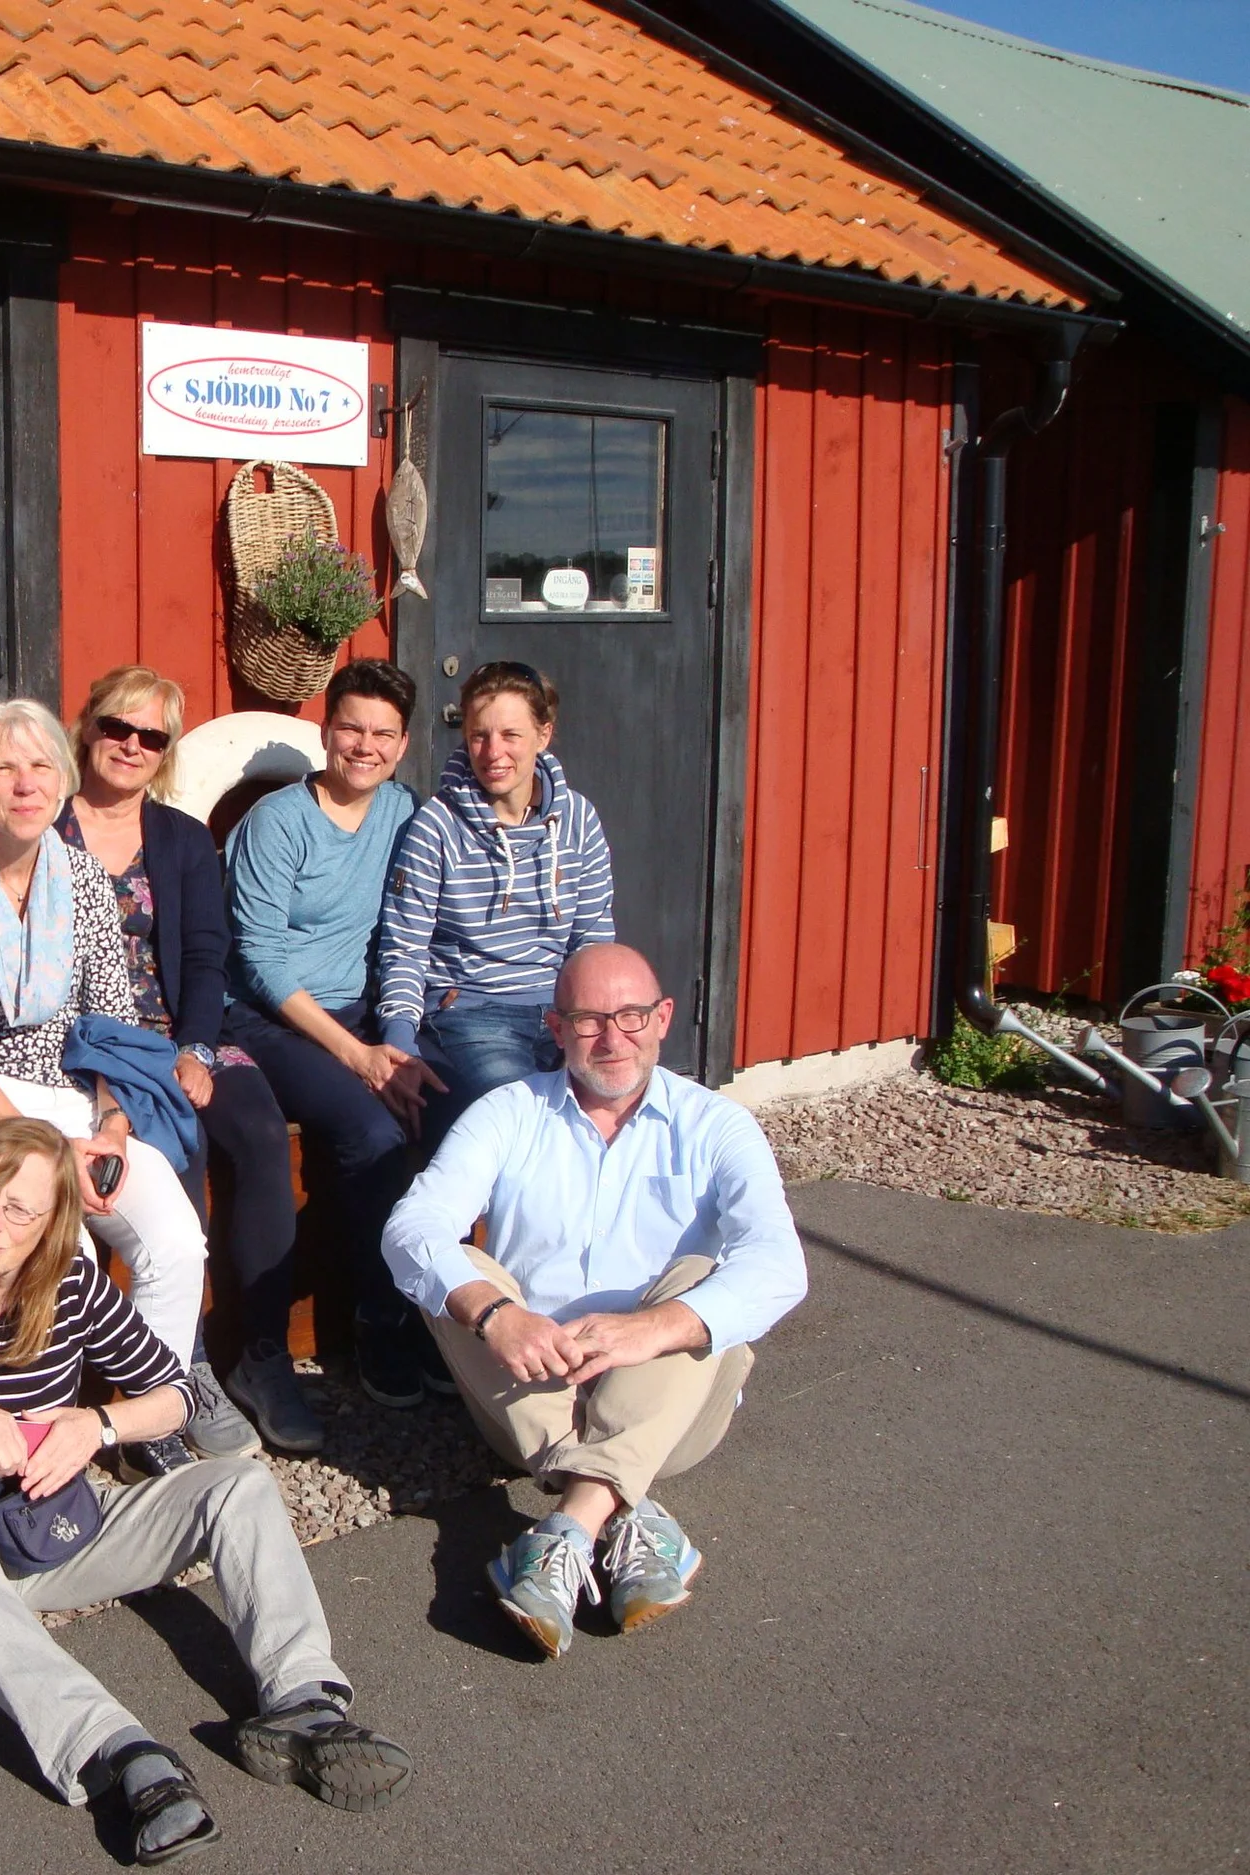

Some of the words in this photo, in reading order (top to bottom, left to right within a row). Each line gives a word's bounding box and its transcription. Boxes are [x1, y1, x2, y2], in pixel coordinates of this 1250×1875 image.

[227, 362, 292, 382] hemtrevligt
[185, 375, 282, 410] SJÖBOD
[195, 406, 268, 430] heminredning
[273, 416, 322, 430] presenter
[553, 573, 582, 585] INGÅNG
